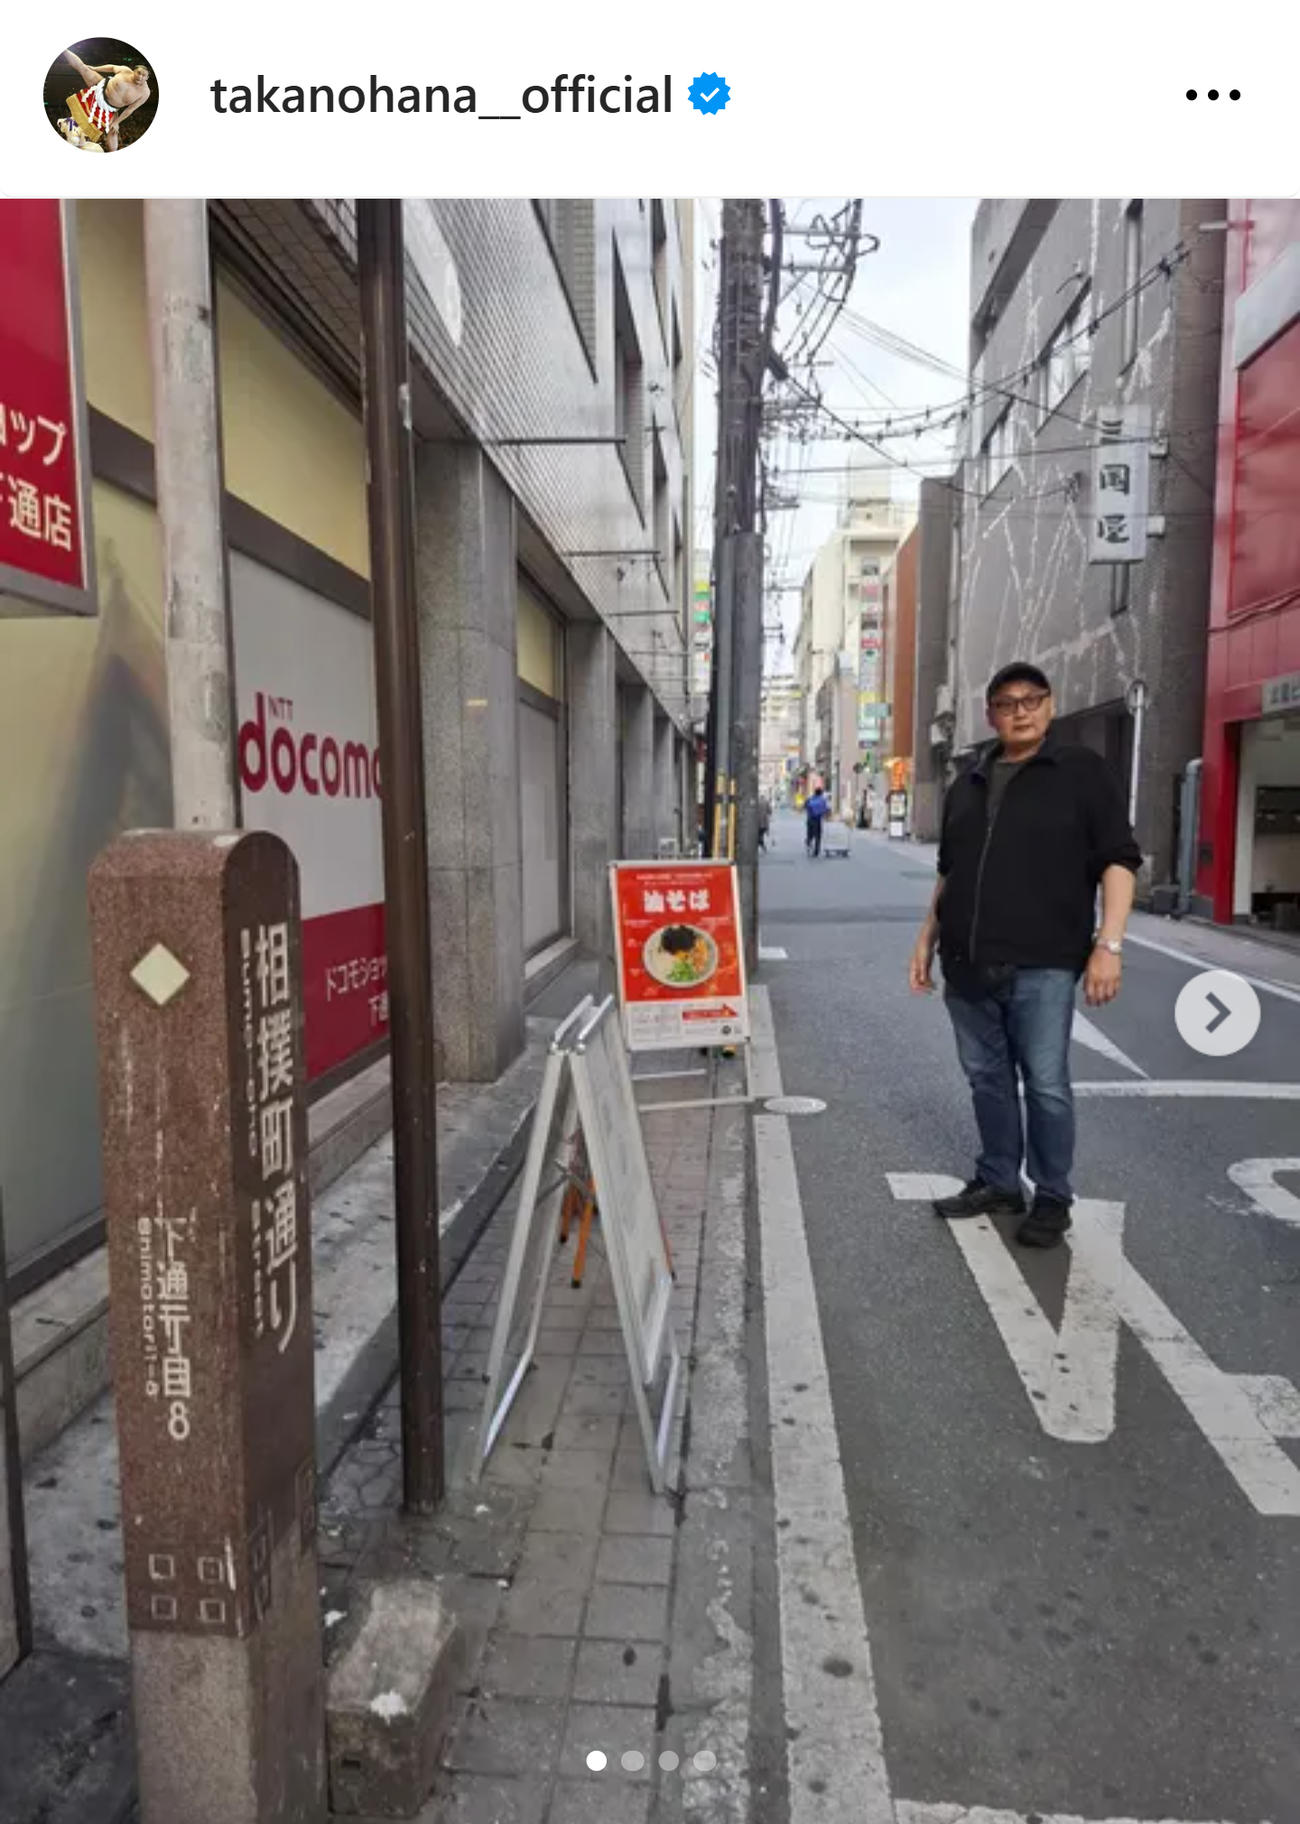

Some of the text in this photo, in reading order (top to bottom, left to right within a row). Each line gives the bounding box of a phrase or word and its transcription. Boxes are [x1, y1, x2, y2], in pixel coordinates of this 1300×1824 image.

[0, 472, 72, 551] 通店
[267, 694, 294, 722] NTT
[255, 921, 298, 1354] 相撲町通り
